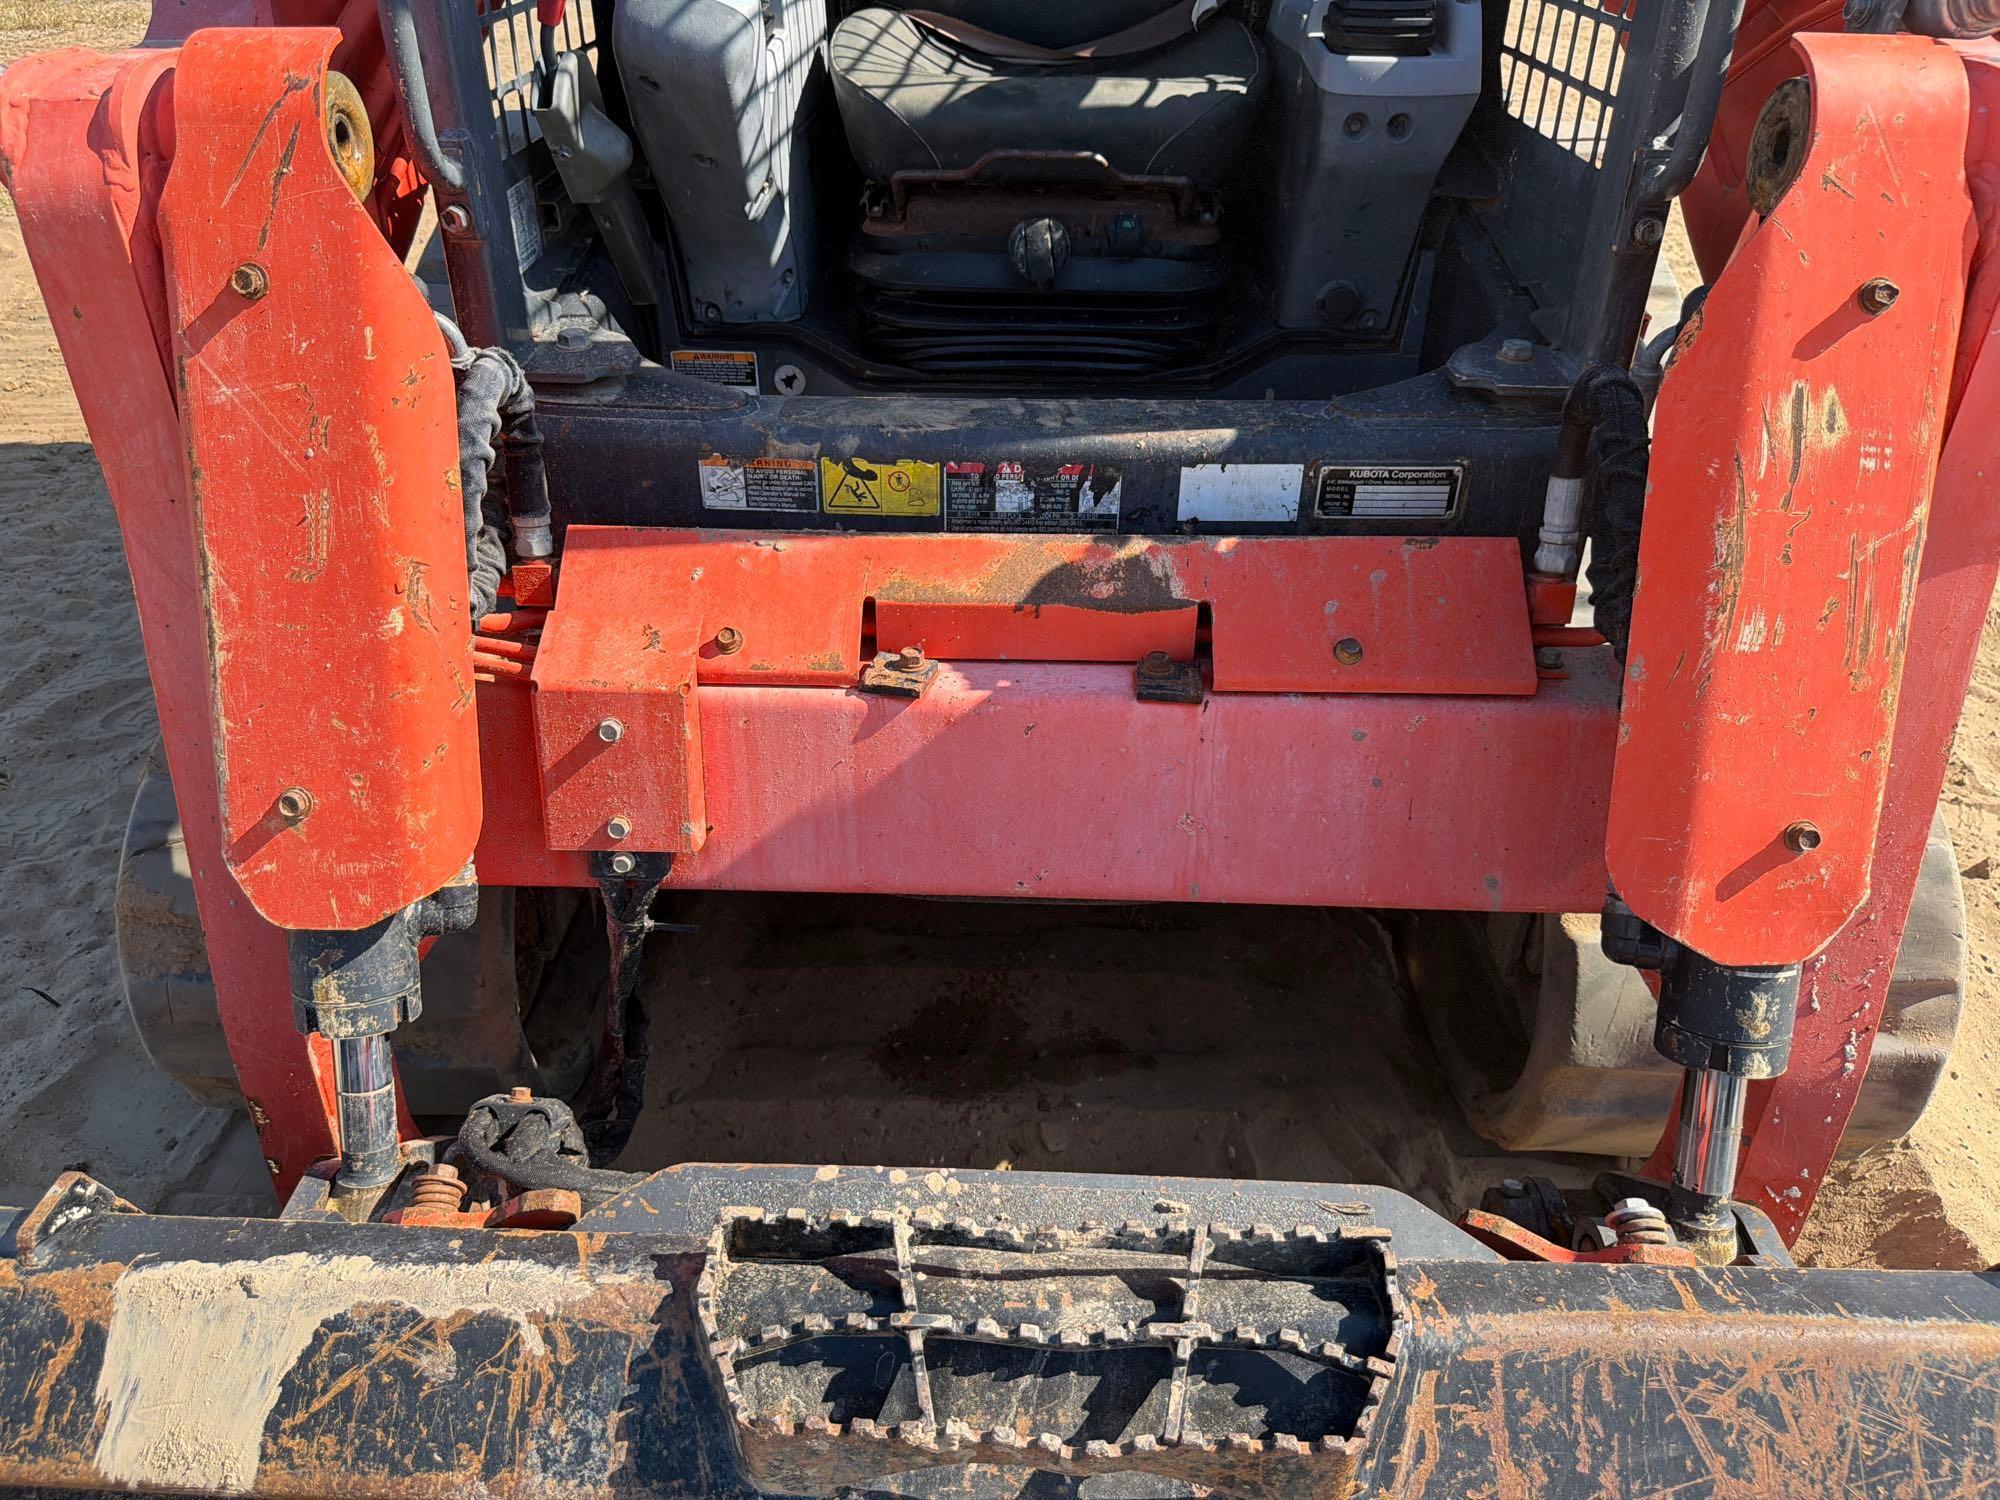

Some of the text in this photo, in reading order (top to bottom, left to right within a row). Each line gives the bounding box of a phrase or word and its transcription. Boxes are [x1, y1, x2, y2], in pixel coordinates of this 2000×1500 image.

[699, 353, 735, 361] WARNING
[1349, 470, 1446, 480] KUBOTA Corporation
